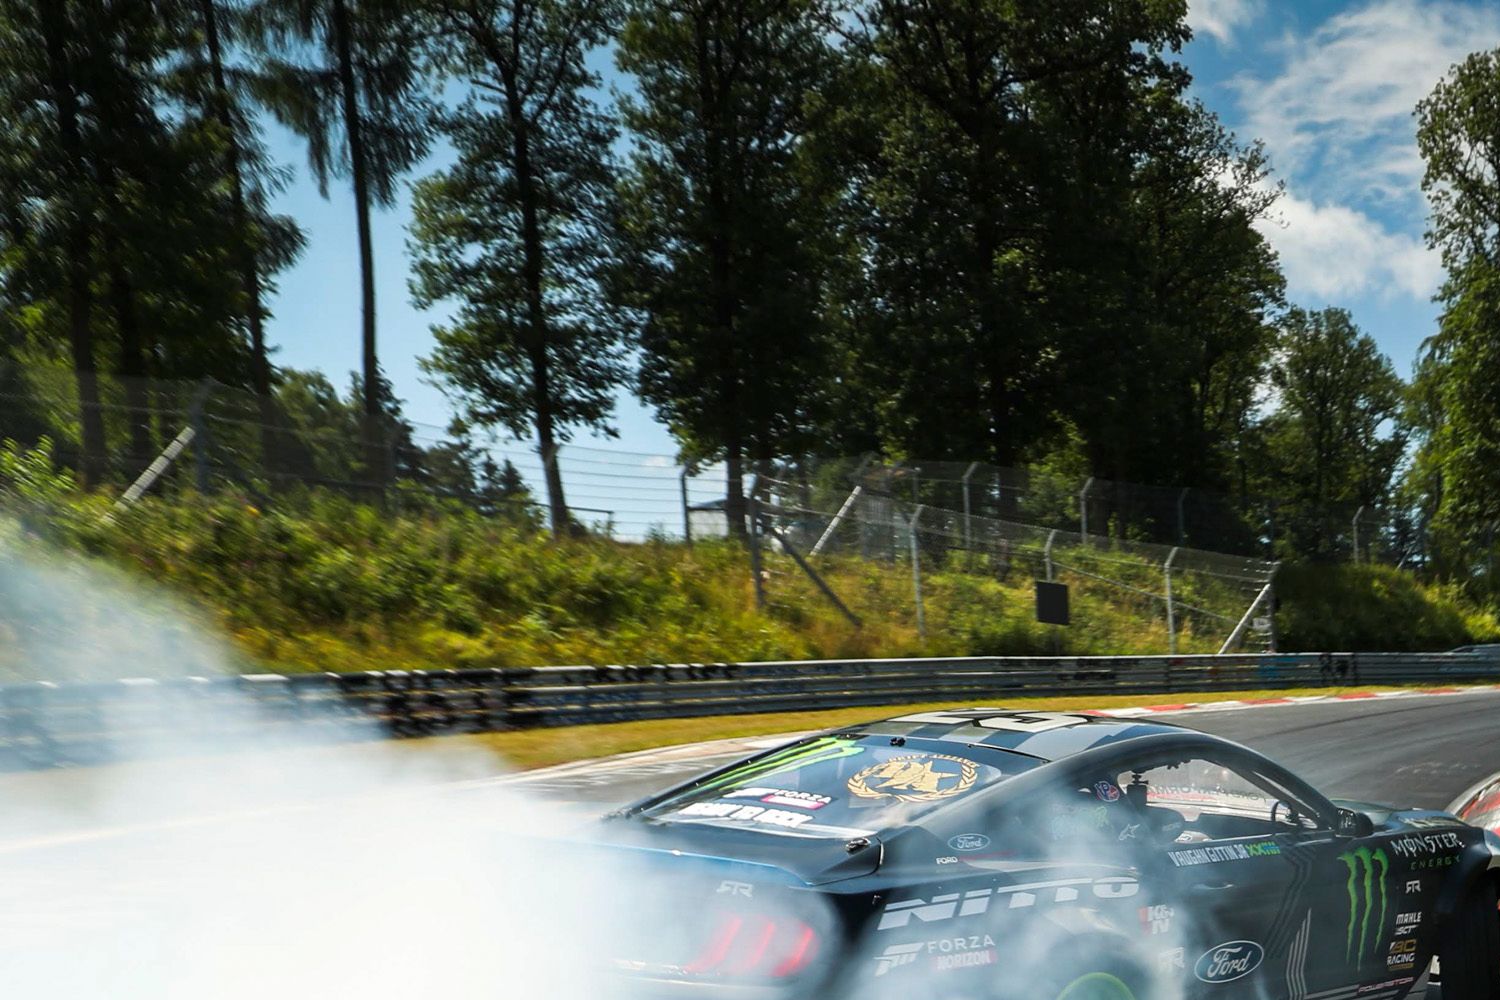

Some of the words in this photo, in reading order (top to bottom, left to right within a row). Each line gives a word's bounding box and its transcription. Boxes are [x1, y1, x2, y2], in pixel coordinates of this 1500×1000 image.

[775, 789, 832, 804] FORZA
[956, 836, 982, 849] Ford
[1391, 832, 1466, 858] MONSTER
[936, 856, 958, 865] FORD
[1168, 848, 1211, 867] VAUGHN
[1204, 845, 1238, 862] GITTIN
[1411, 854, 1461, 870] ENERGY
[877, 876, 1140, 931] NITTO
[1395, 911, 1422, 924] MAHLE
[927, 934, 996, 953] FORZA
[936, 950, 991, 970] HORIZON
[1207, 946, 1252, 978] Ford
[1386, 953, 1415, 966] RACING
